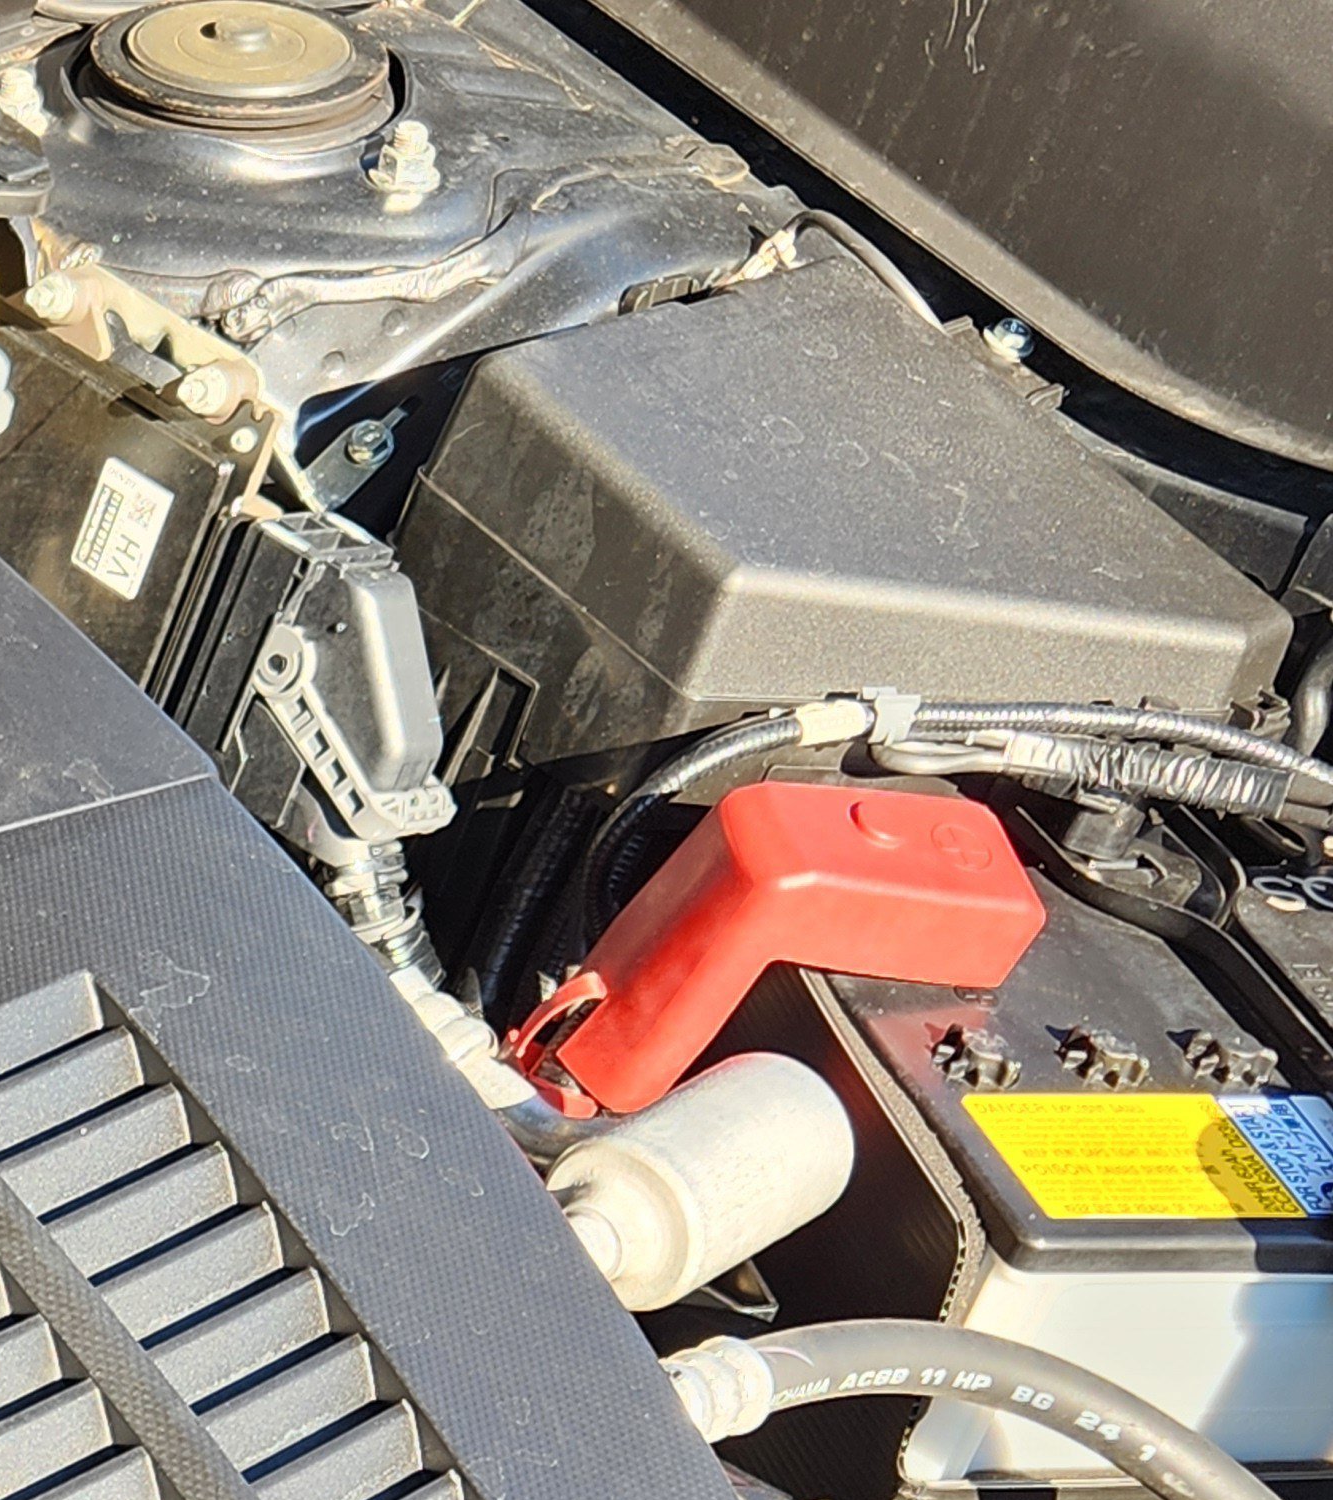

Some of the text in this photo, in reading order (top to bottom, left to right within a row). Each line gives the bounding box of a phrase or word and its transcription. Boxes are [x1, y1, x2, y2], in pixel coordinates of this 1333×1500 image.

[107, 533, 141, 578] VH
[951, 1370, 993, 1391] HP
[1073, 1410, 1121, 1441] 24
